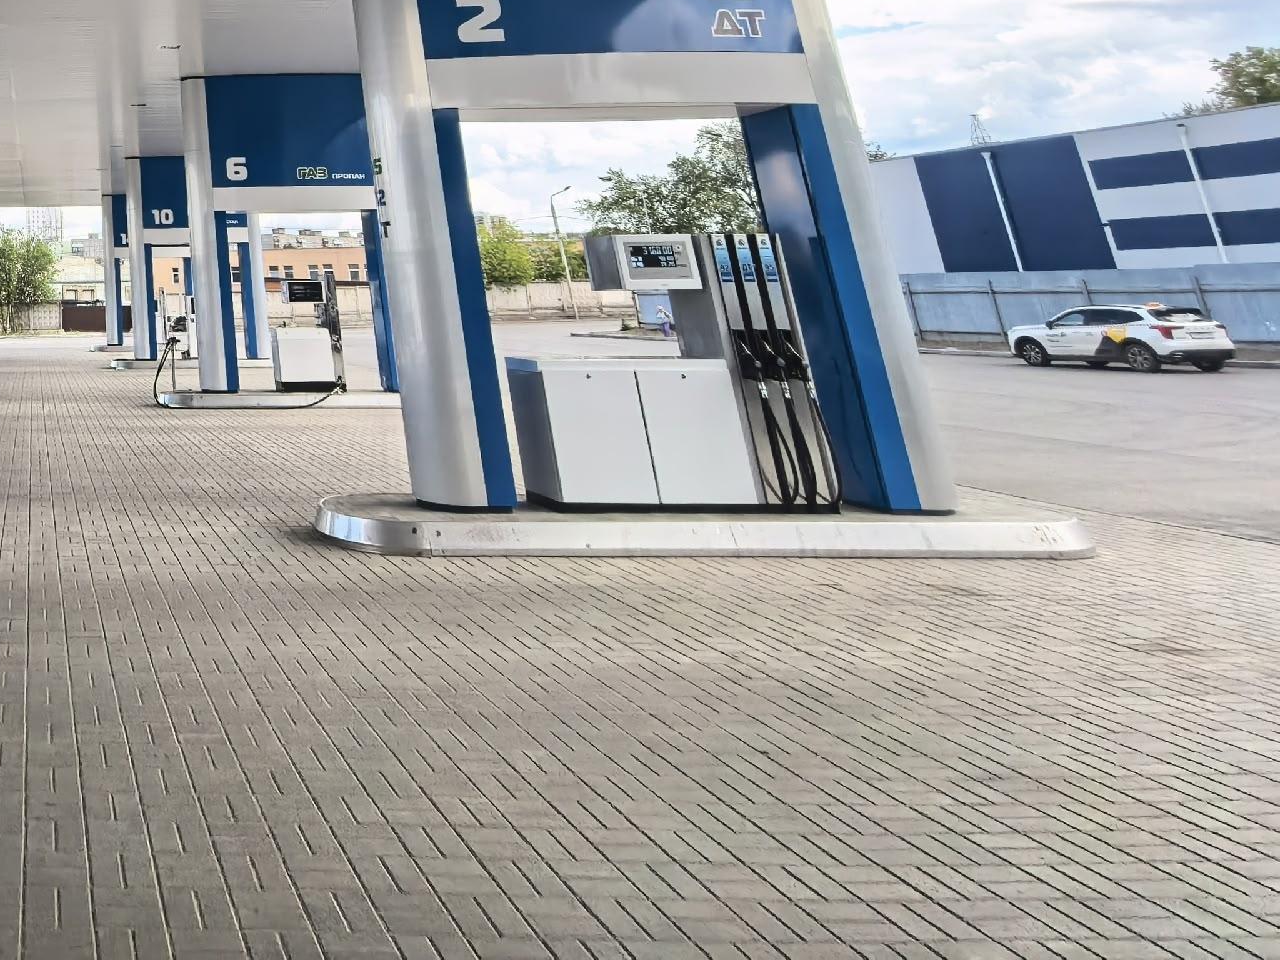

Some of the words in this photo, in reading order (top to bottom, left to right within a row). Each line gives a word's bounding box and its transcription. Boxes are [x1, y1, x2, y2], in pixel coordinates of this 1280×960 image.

[711, 8, 766, 37] ДТ
[225, 156, 248, 181] 6
[297, 166, 328, 180] ГАЗ
[152, 208, 175, 225] 10
